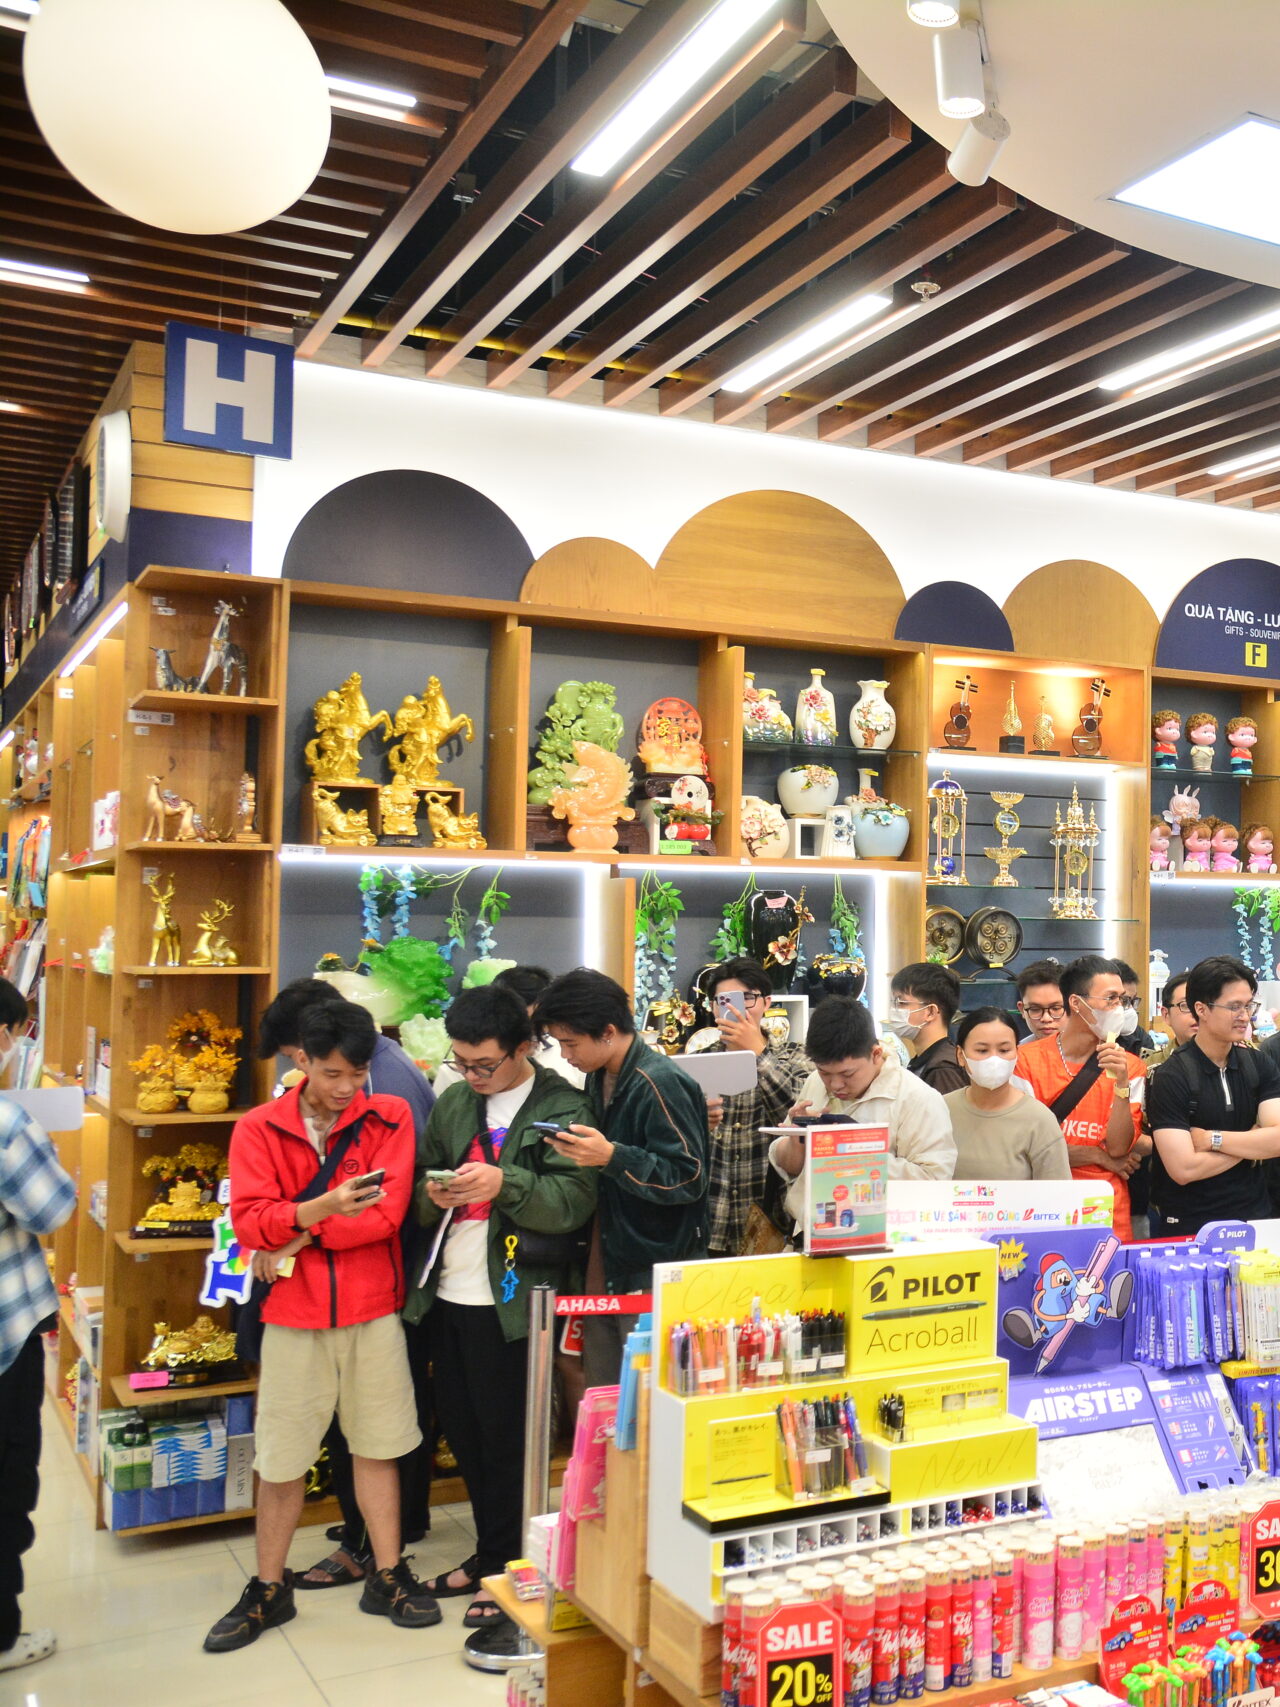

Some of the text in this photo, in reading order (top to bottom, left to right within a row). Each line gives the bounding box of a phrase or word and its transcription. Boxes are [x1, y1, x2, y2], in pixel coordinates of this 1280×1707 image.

[184, 338, 276, 444] H
[1184, 603, 1214, 620] QUÀ
[1217, 606, 1254, 625] TẶNG
[1225, 625, 1244, 636] GIFTS
[1252, 644, 1262, 665] F
[1033, 1213, 1060, 1221] BITEX
[1227, 1230, 1247, 1238] PILOT
[903, 1271, 981, 1300] PILOT
[555, 1298, 620, 1312] AHASA
[866, 1316, 978, 1355] Acroball
[1213, 1314, 1223, 1357] AIRSTEP
[1023, 1386, 1143, 1424] AIRSTEP
[237, 1448, 247, 1477] OCEAN
[766, 1620, 834, 1653] SALE
[771, 1661, 833, 1707] 20%
[815, 1693, 832, 1703] OFF
